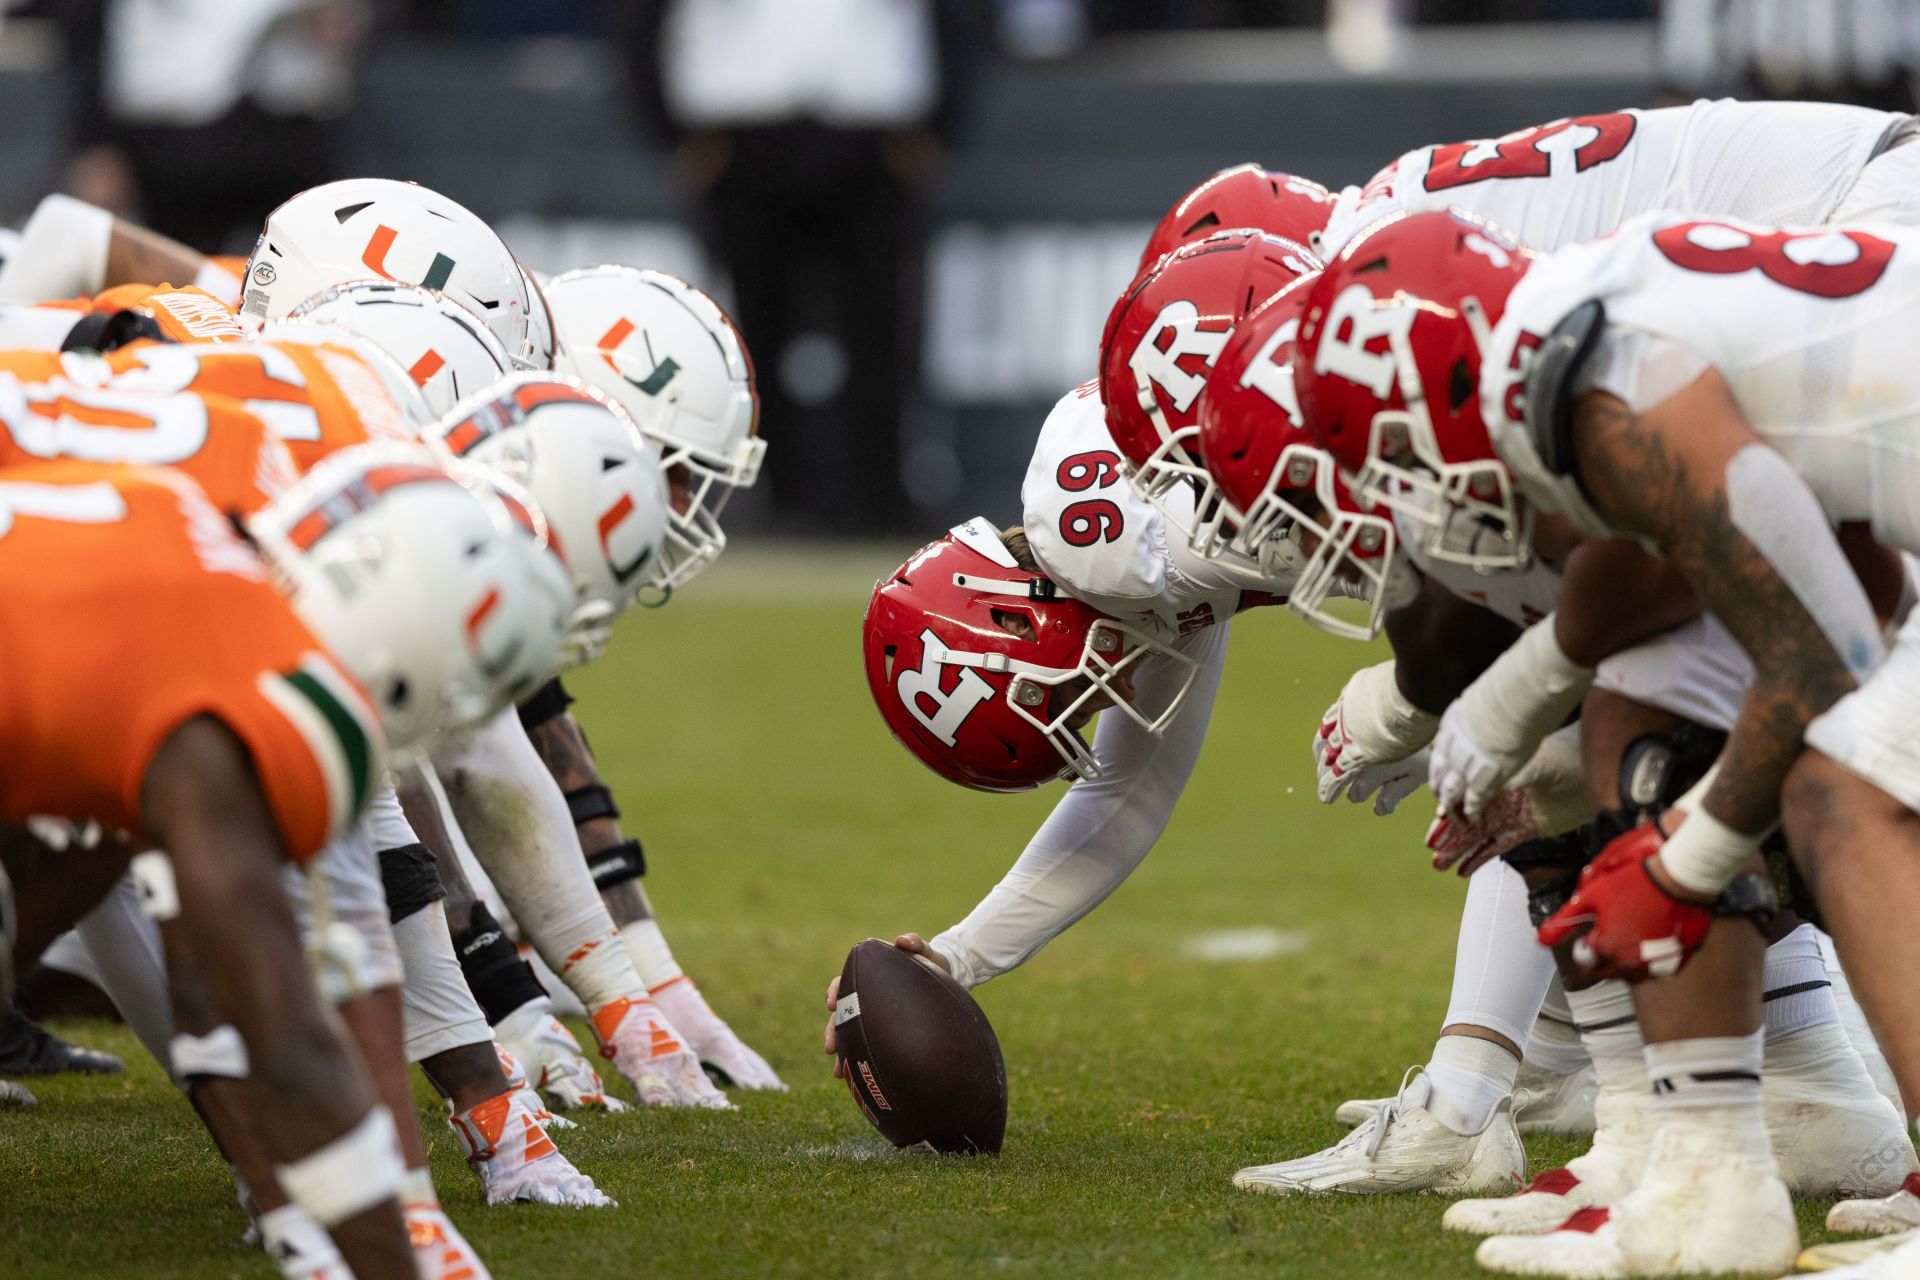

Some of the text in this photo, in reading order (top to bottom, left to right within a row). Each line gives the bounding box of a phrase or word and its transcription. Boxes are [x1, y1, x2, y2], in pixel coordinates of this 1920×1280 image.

[1128, 299, 1237, 414] R
[1315, 284, 1420, 401] R
[897, 627, 997, 748] R
